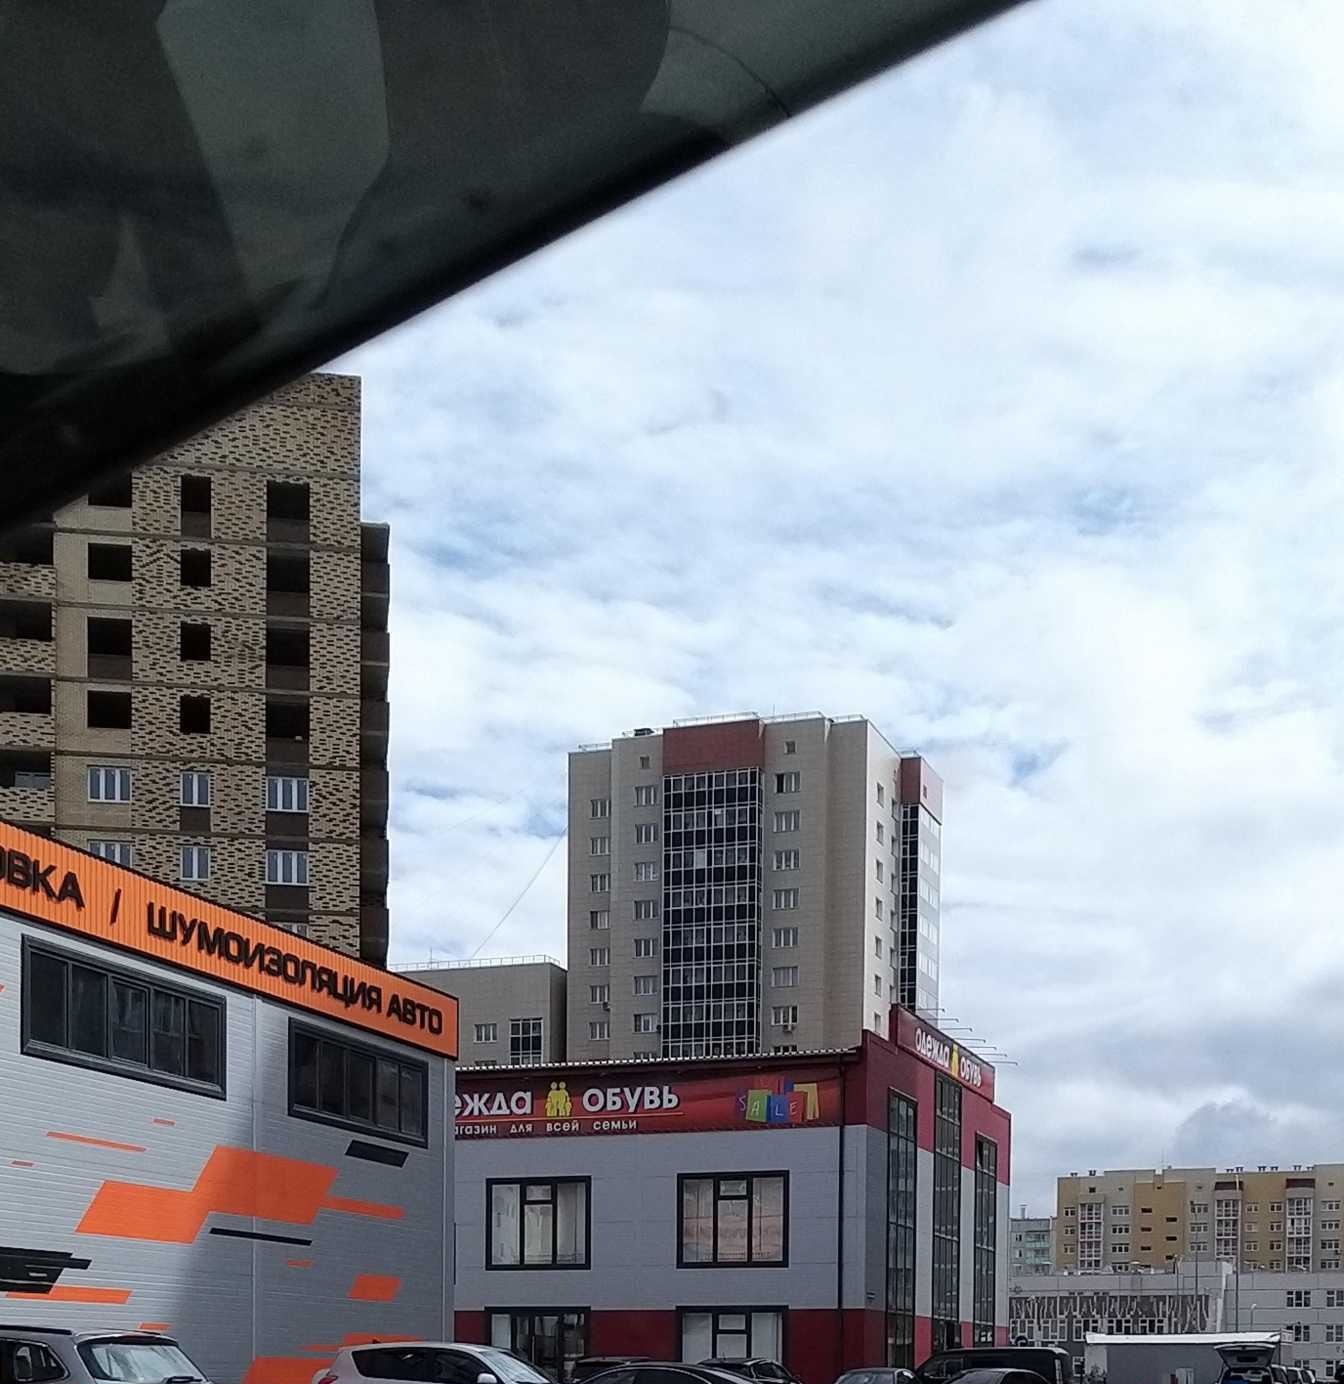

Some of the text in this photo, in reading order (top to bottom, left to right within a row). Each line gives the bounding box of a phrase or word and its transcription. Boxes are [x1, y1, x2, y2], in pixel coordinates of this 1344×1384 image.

[0, 846, 85, 911] ВКА
[147, 901, 382, 1014] ШУМОИЗОЛЯЦИЯ
[386, 993, 443, 1035] АВТО
[960, 1057, 982, 1088] ОБУВЬ
[582, 1086, 679, 1113] ОБУВЬ
[736, 1095, 799, 1117] SALE
[510, 1123, 533, 1134] для
[546, 1120, 580, 1132] всей
[593, 1119, 637, 1131] семьи
